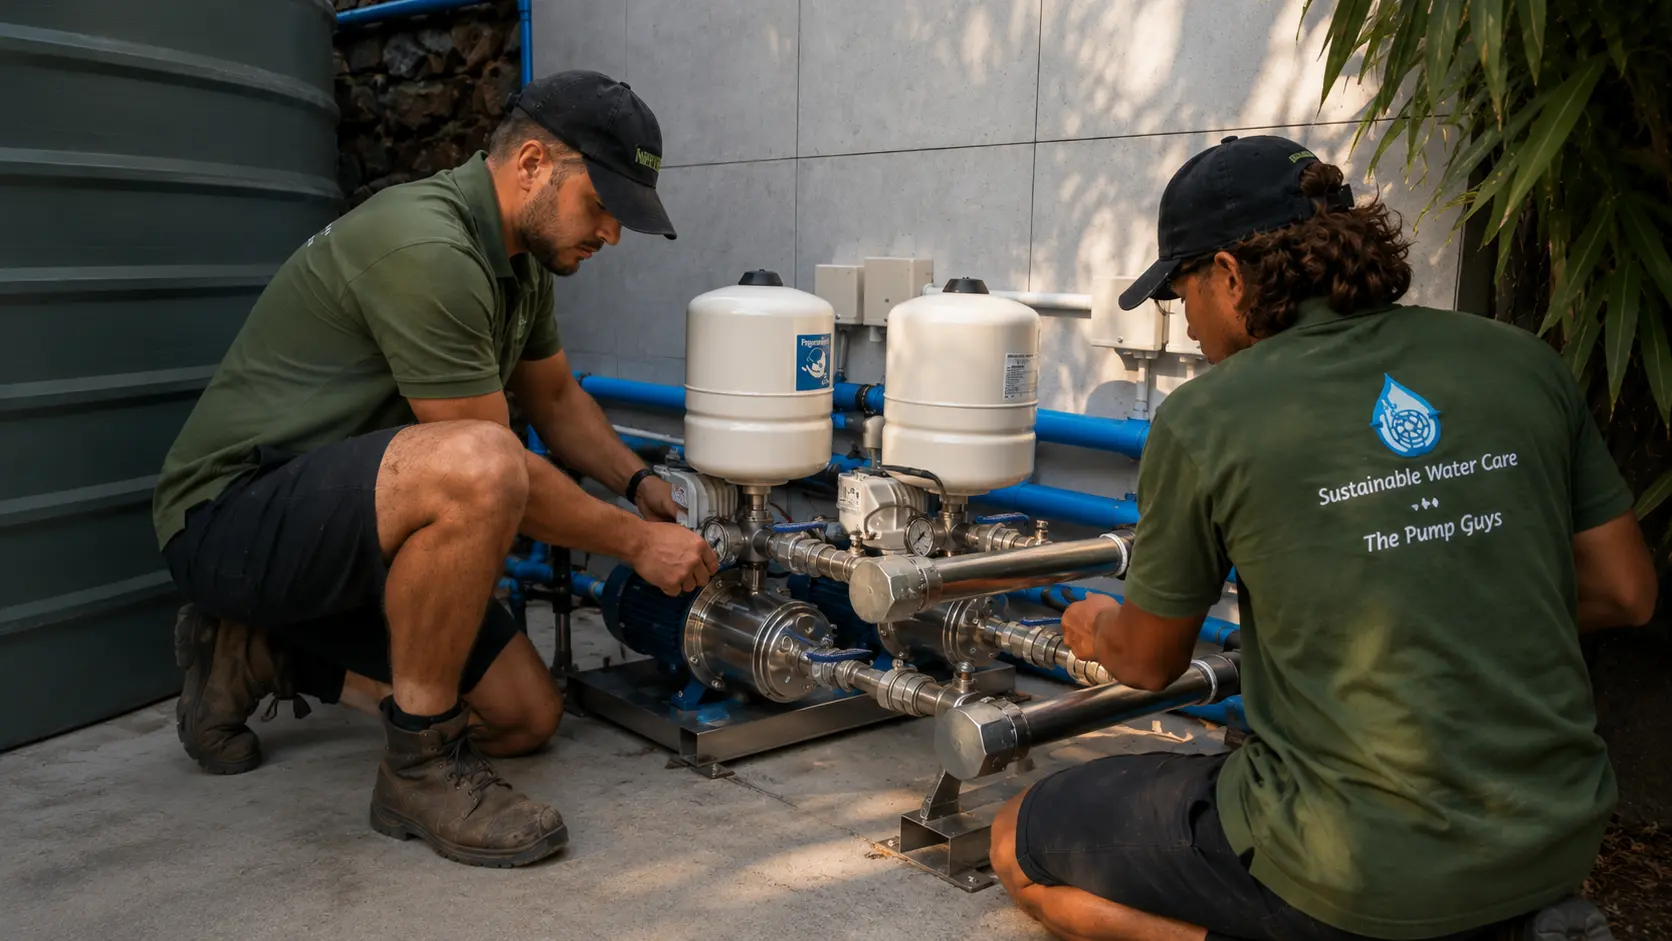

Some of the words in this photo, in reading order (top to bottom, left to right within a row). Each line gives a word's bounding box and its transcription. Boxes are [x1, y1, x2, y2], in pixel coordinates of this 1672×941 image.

[1319, 468, 1422, 506] Sustainable
[1425, 459, 1477, 482] Water
[1481, 452, 1518, 471] Care
[1363, 531, 1399, 552] The
[1404, 521, 1455, 544] Pump
[1460, 512, 1503, 536] Guys
